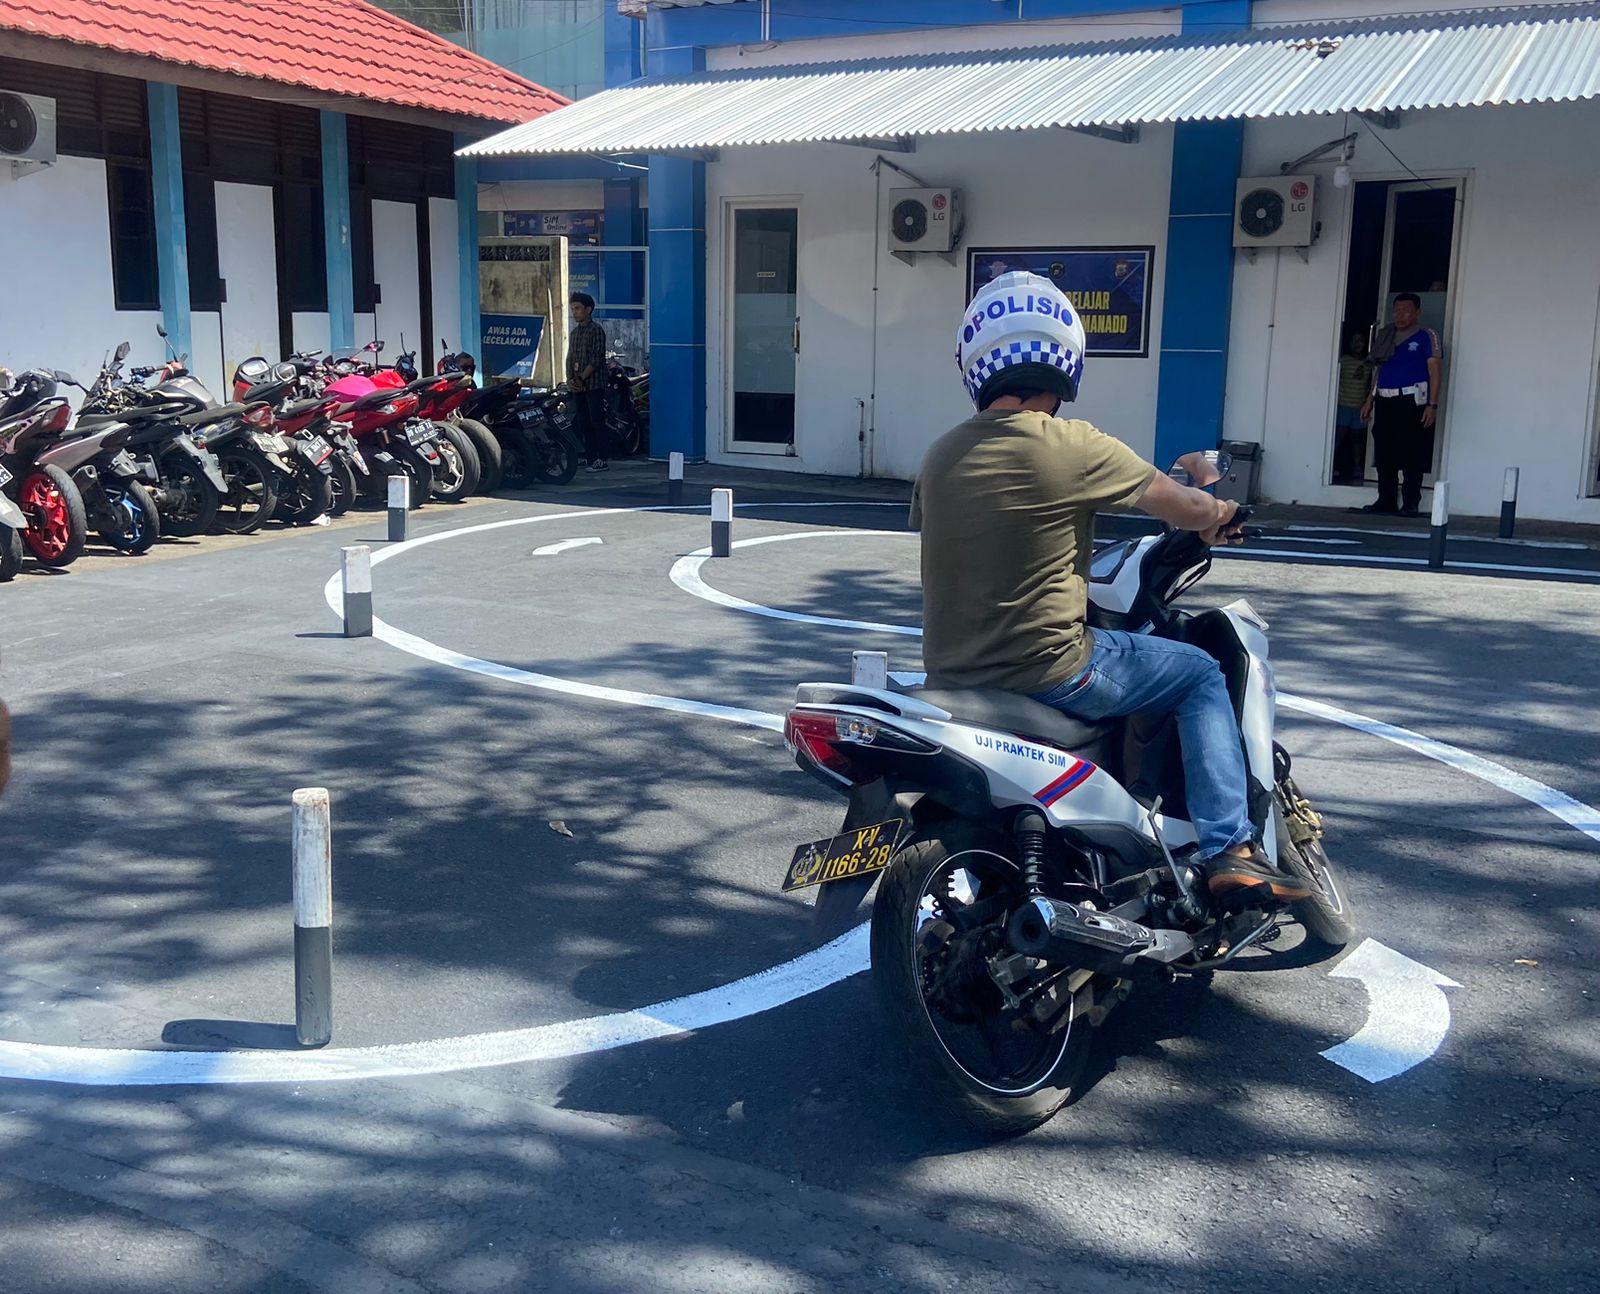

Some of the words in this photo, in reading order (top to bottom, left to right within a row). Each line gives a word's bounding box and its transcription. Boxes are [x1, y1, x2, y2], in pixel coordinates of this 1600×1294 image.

[1291, 203, 1306, 212] LG
[543, 215, 560, 224] SIM
[933, 212, 945, 221] LG
[546, 223, 567, 231] Online
[972, 295, 1061, 332] POLISI
[1080, 315, 1128, 333] MANADO
[487, 326, 510, 335] AWAS
[511, 327, 527, 336] ADA
[975, 734, 993, 749] UJI
[995, 740, 1045, 762] PRAKTEK
[1048, 752, 1066, 767] SIM
[823, 844, 891, 879] 1166-28
